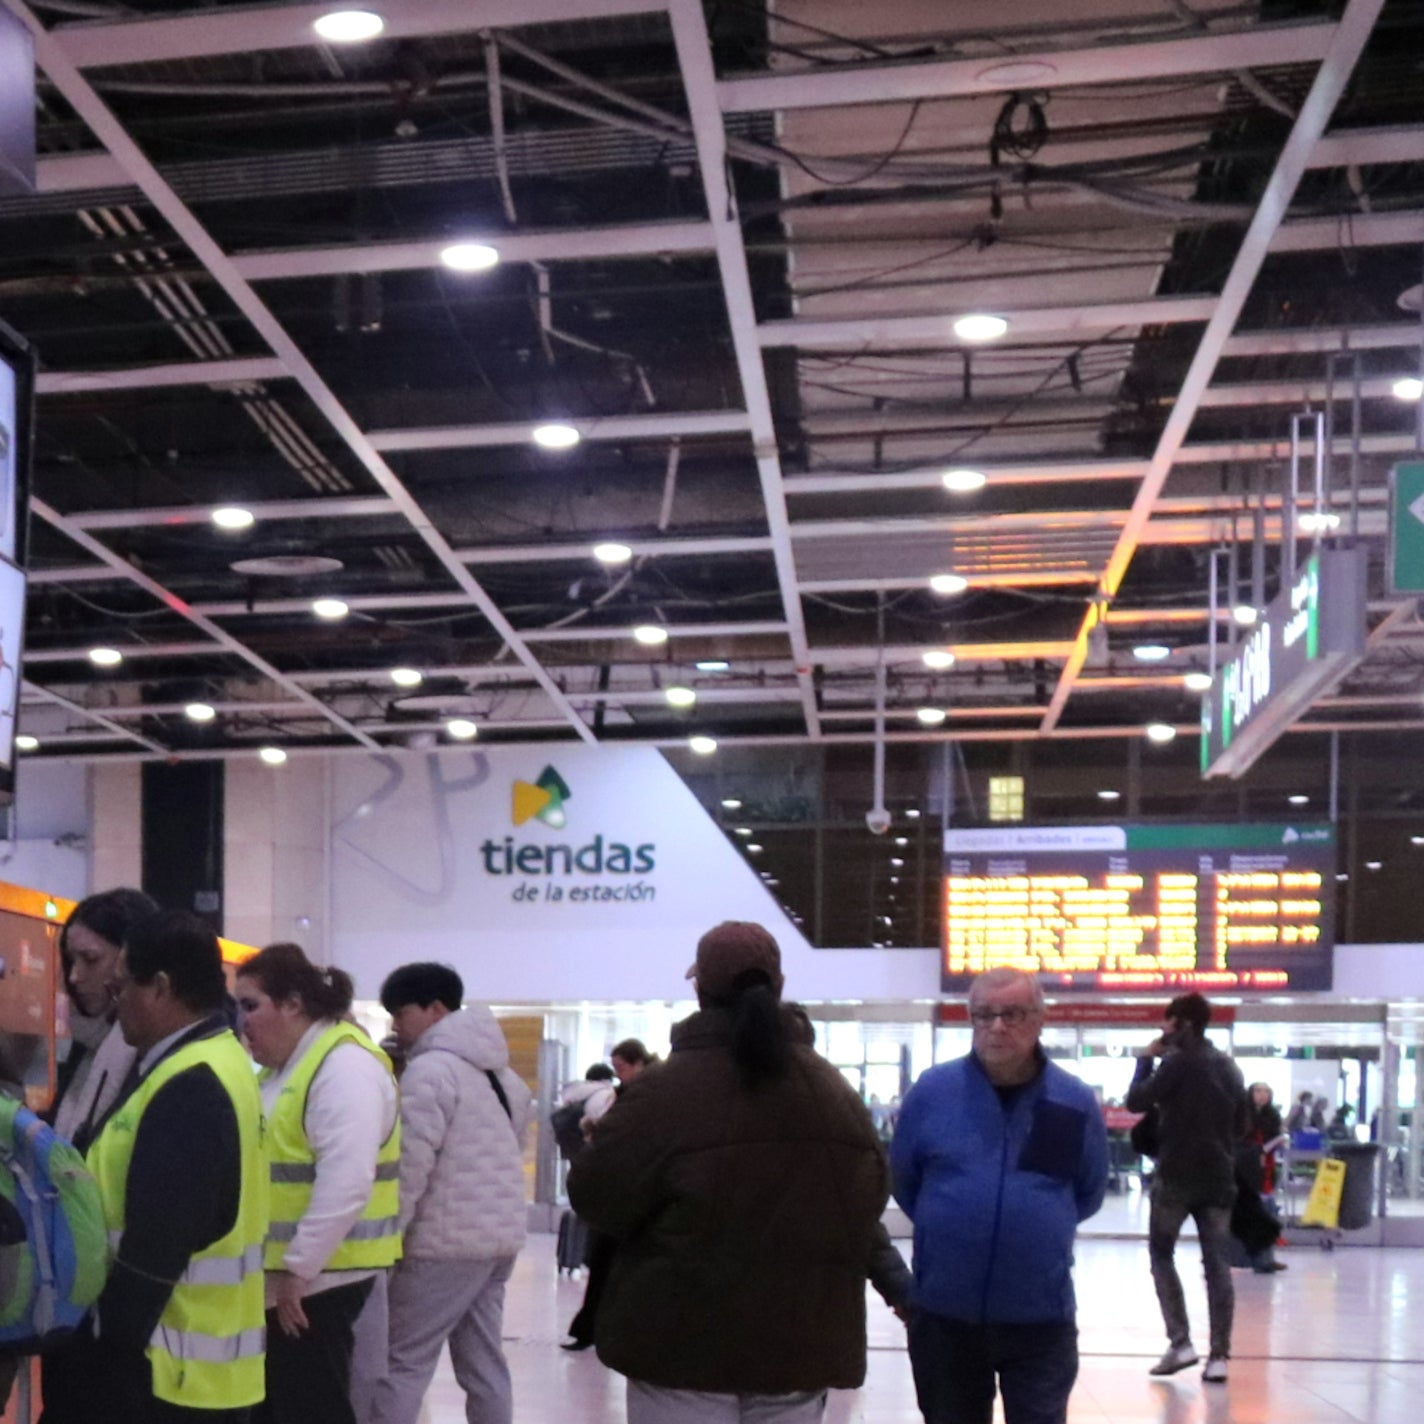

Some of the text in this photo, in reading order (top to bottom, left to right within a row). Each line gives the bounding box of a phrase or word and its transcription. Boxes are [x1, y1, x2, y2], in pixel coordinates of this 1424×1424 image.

[481, 834, 656, 876] tiendas
[512, 881, 656, 903] de la estación
